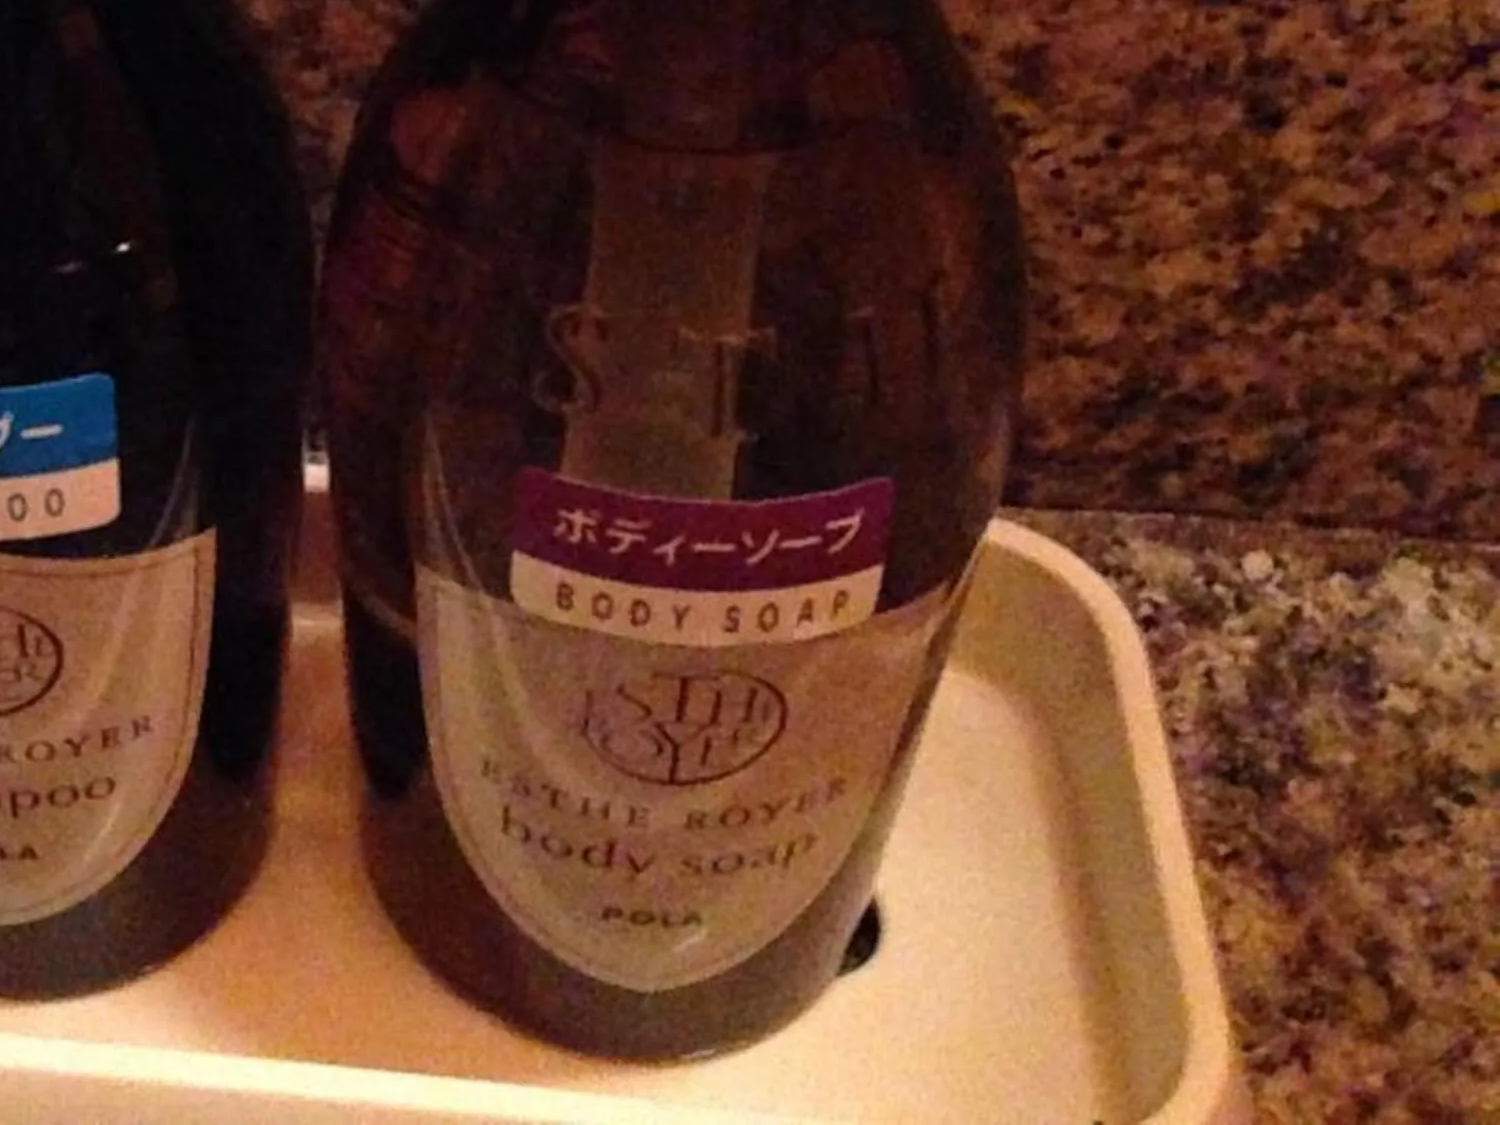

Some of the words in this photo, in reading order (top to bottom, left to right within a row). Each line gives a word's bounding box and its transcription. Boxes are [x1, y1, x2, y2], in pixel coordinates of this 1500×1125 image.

[555, 579, 693, 630] BODY
[722, 588, 852, 634] SOAP
[500, 803, 656, 881] body
[599, 905, 704, 929] POLA
